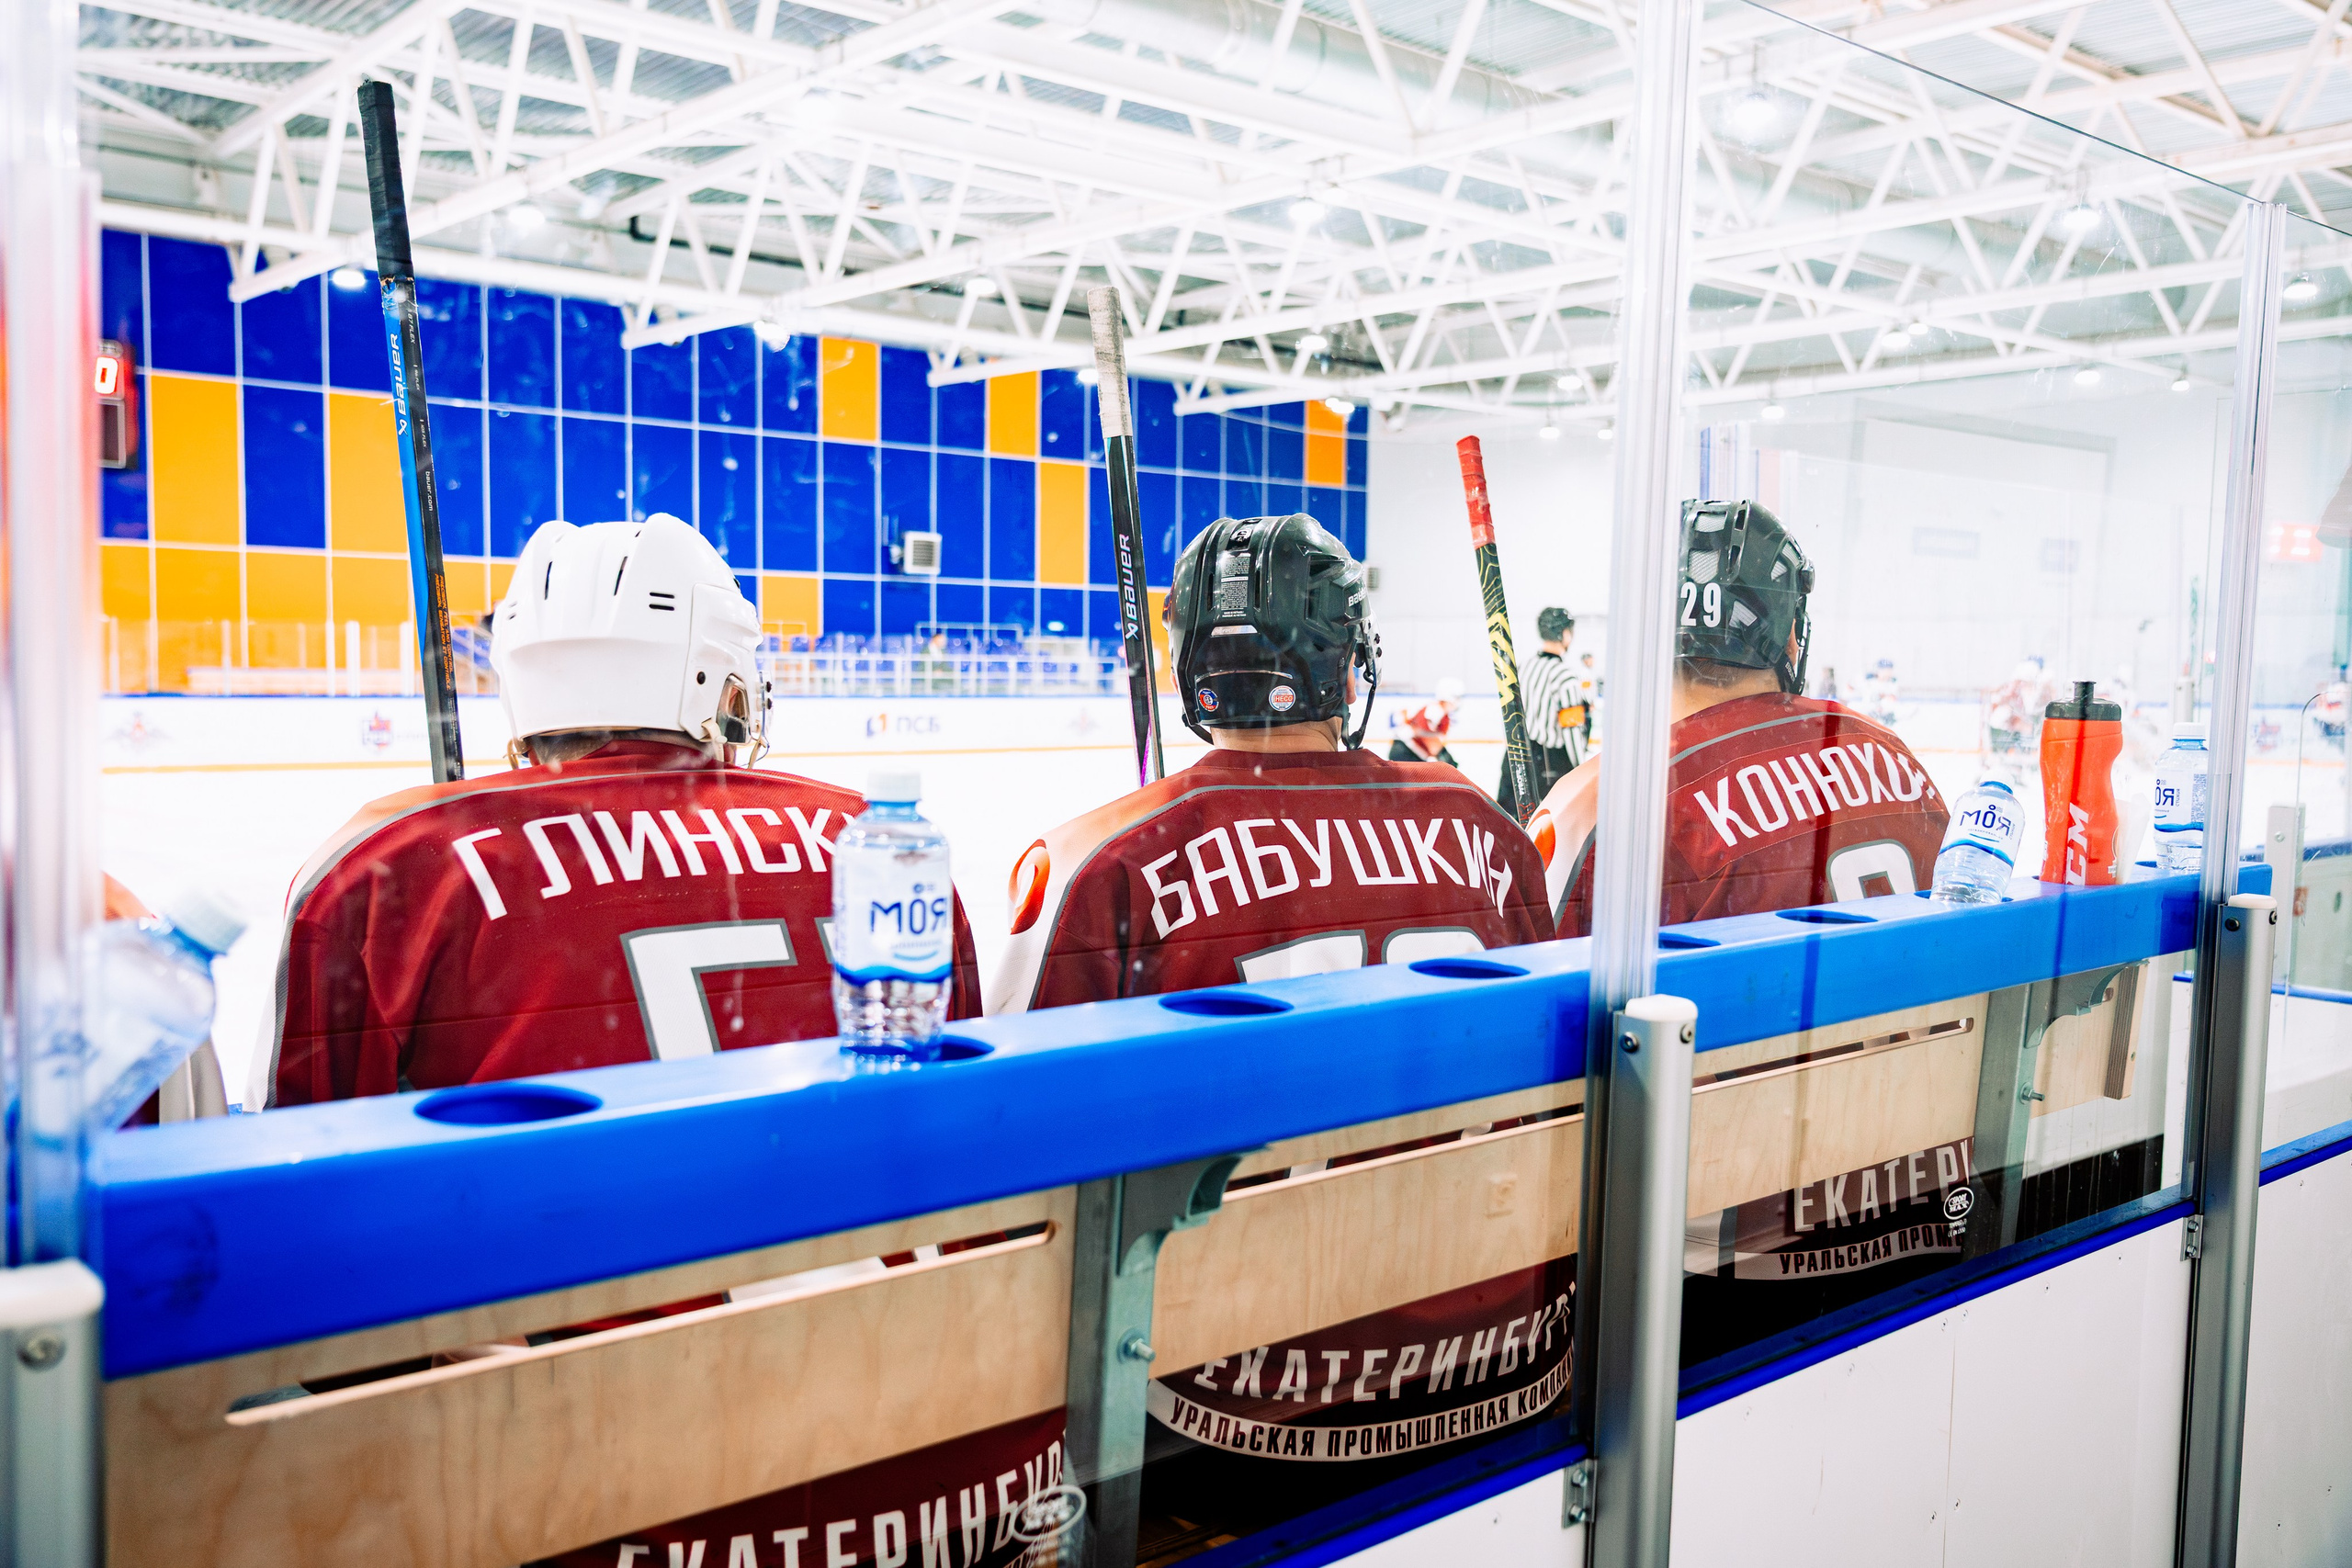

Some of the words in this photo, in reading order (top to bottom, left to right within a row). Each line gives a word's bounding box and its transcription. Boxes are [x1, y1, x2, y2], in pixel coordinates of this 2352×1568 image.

[1680, 581, 1722, 627] 29
[453, 807, 855, 920] ГЛИНСК
[1140, 818, 1513, 941] БАБУШКИН
[2066, 802, 2089, 886] CM
[1780, 1235, 1892, 1275] УРАЛЬСКАЯ
[1194, 1280, 1577, 1404] ЕКАТЕРИНБУР
[1170, 1395, 1316, 1458] УРАЛЬСКАЯ
[1328, 1395, 1509, 1458] ПРОМЫШЛЕННАЯ
[1518, 1348, 1572, 1416] КОМПАН
[616, 1429, 1066, 1568] ТЕРИНБУР
